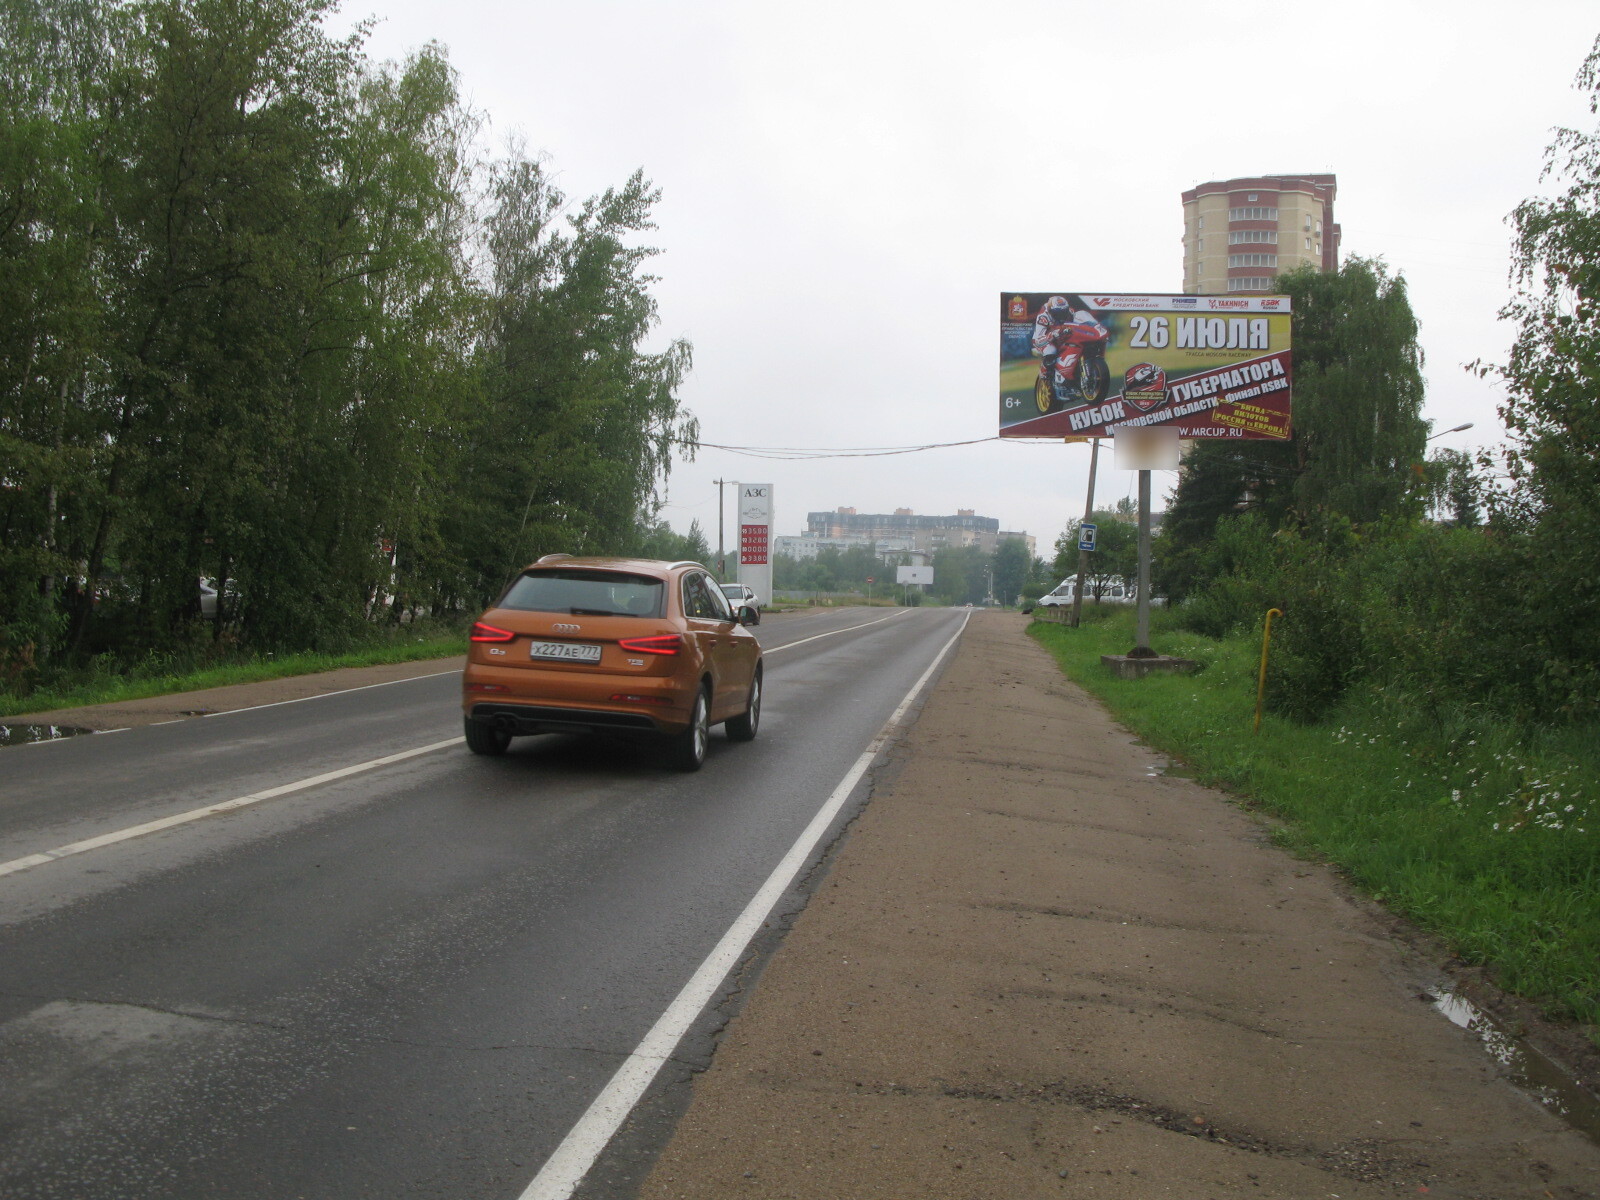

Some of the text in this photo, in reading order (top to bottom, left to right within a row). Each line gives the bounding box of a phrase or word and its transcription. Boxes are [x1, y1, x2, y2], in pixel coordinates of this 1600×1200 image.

[1130, 316, 1269, 350] 26 ИЮЛЯ
[1005, 397, 1022, 409] 6+
[1069, 358, 1285, 431] КУБОК ГУБЕРНАТОРА
[1104, 407, 1174, 436] МКОВСКОЙ
[1173, 396, 1219, 417] ОБЛАСТИ
[1260, 377, 1289, 394] RSBK
[1240, 403, 1265, 414] БИТВА
[1216, 413, 1246, 425] РОССИЯ
[1254, 422, 1283, 434] ЕВРОПА
[744, 488, 767, 498] АЗС
